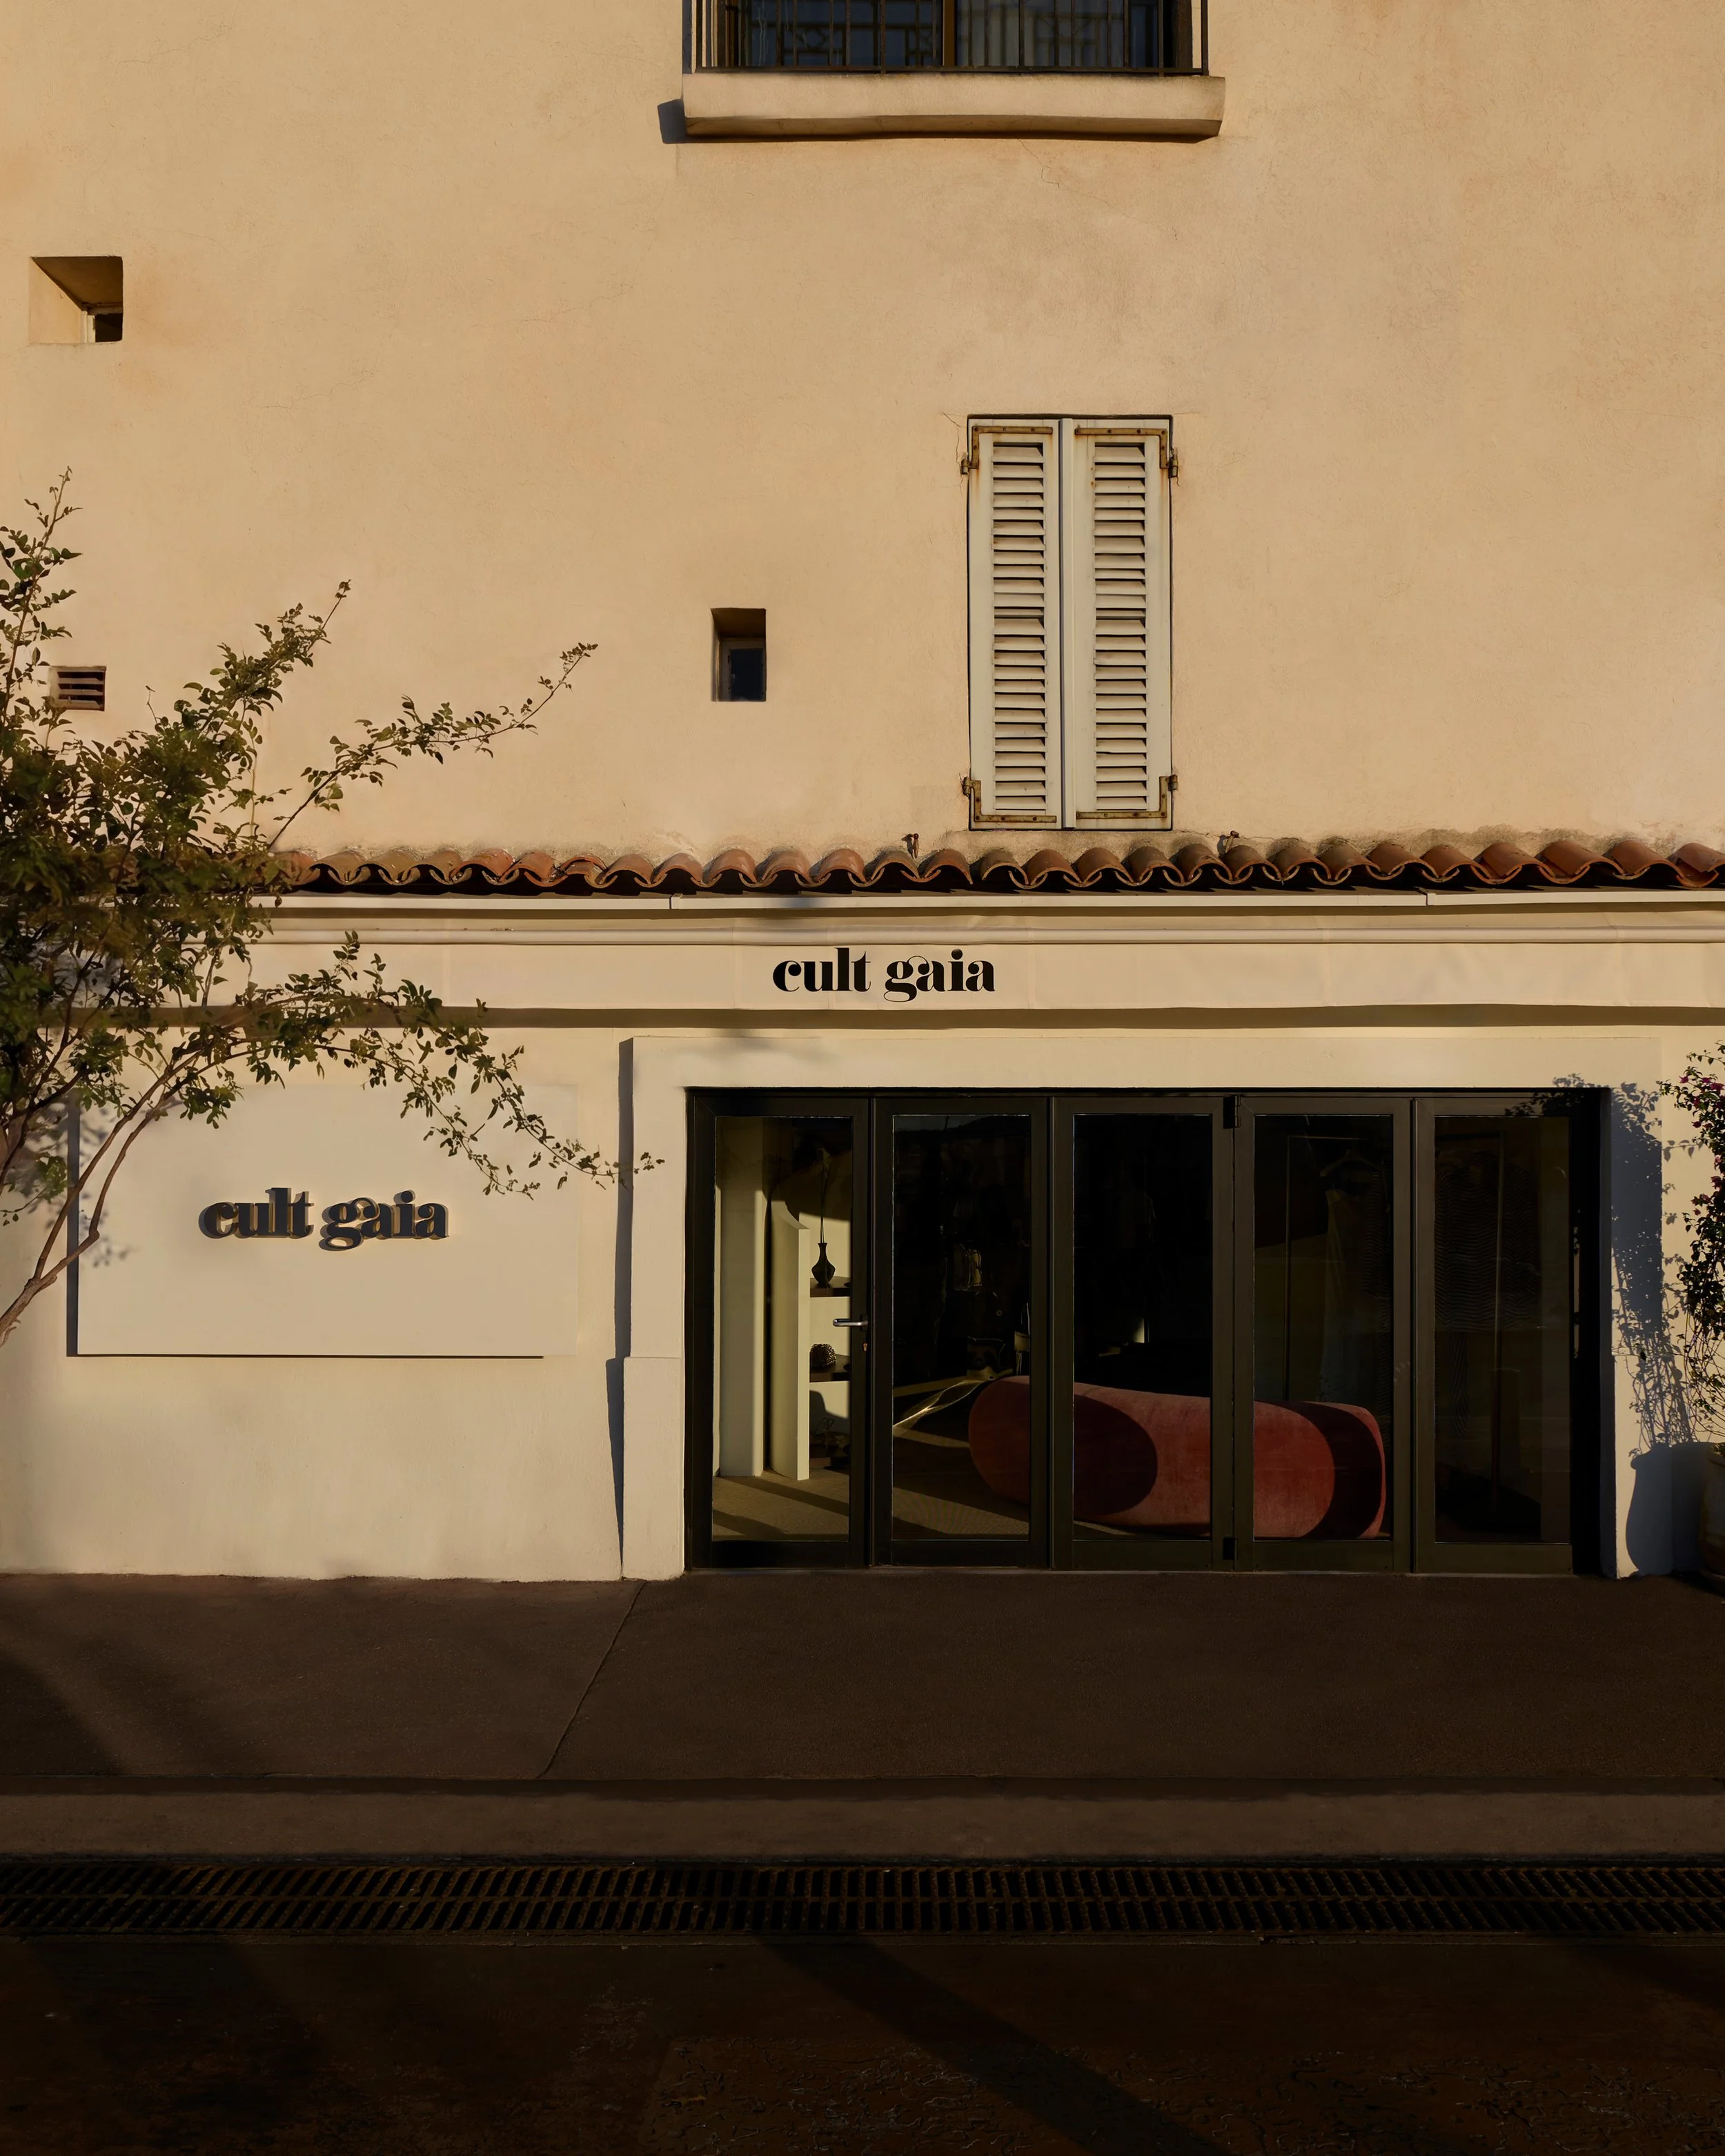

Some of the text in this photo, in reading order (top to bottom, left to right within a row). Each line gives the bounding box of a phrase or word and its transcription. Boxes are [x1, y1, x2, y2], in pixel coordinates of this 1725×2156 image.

[772, 947, 996, 1002] cult gaia
[201, 1187, 448, 1251] cult gaia
